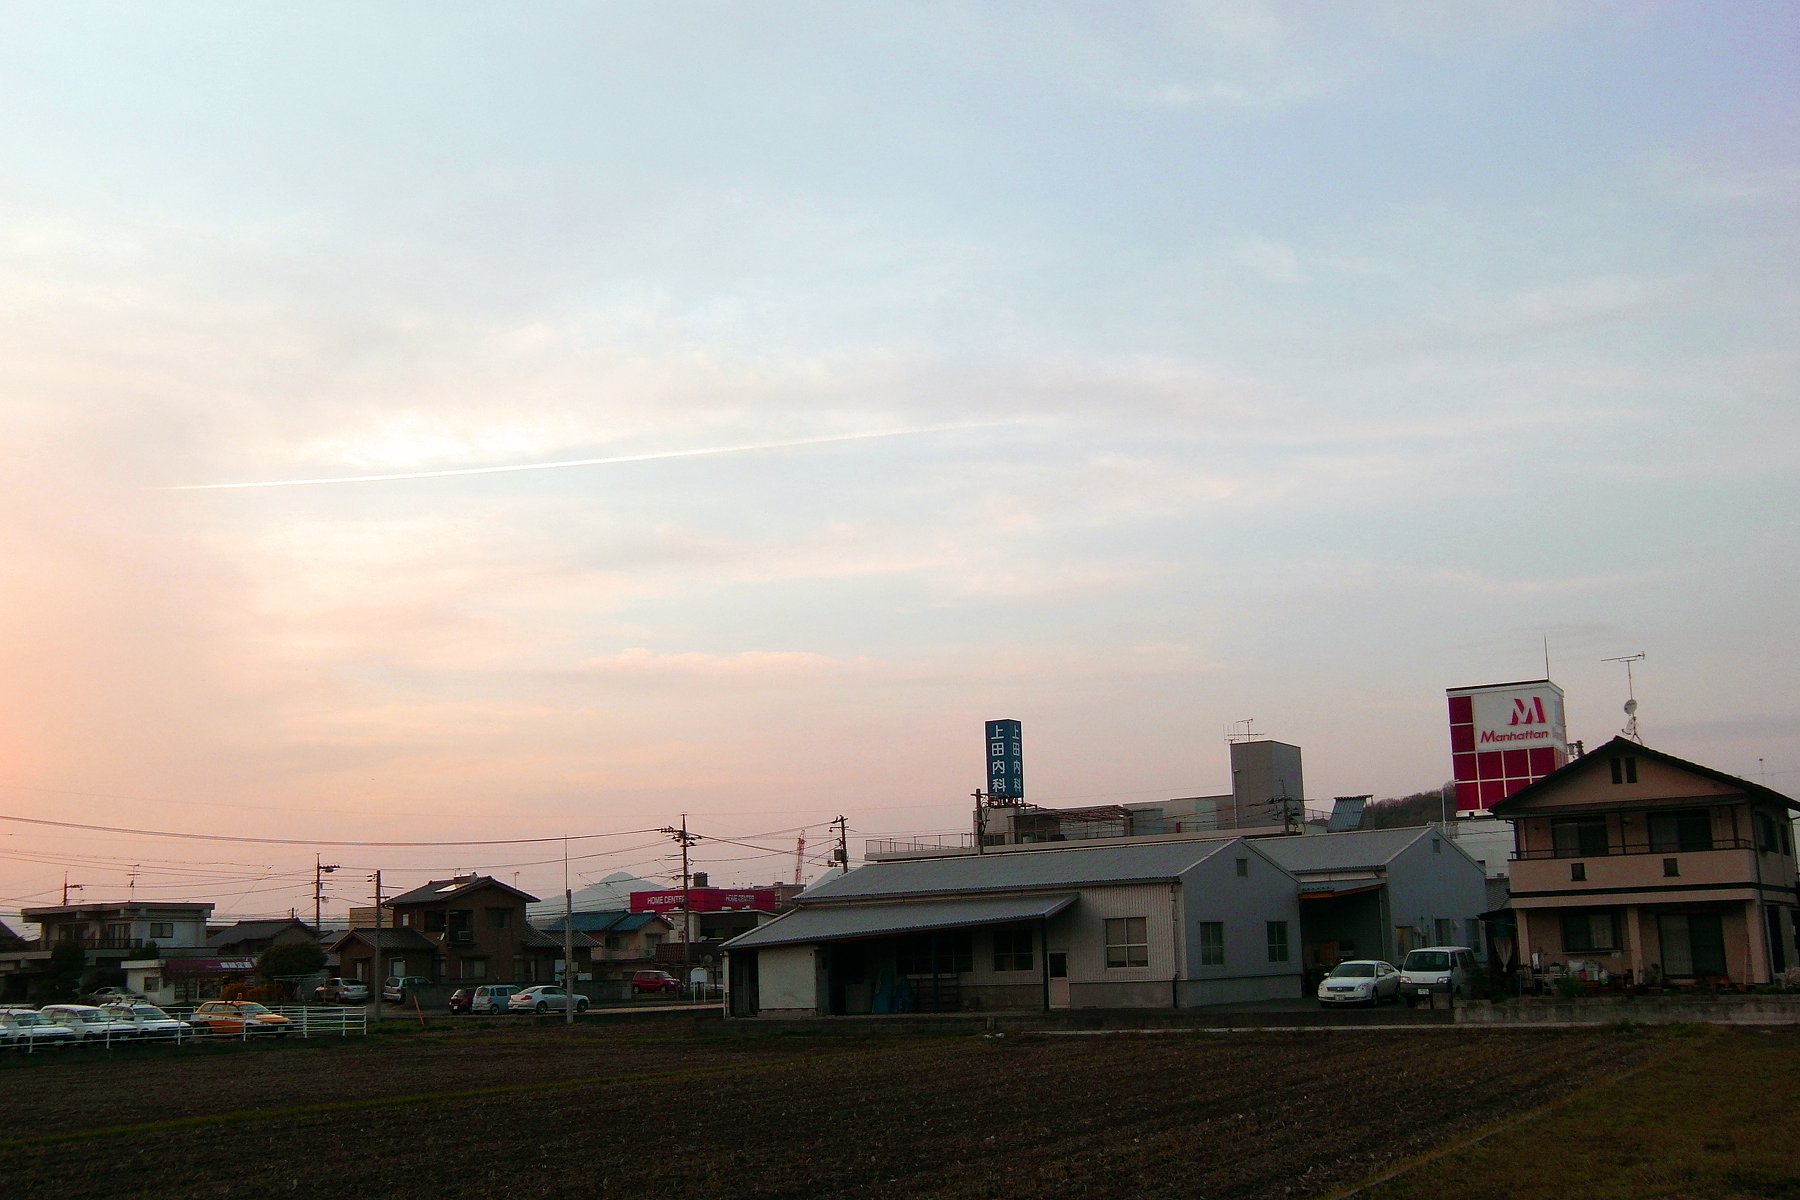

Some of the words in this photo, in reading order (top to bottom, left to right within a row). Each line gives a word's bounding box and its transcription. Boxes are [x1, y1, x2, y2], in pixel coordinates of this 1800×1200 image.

[1480, 730, 1549, 743] Manhattan
[991, 724, 1006, 793] 上田内科
[1012, 724, 1021, 793] 上田内科
[647, 896, 663, 905] HOME
[726, 894, 738, 902] HOME
[738, 894, 754, 902] CENTER
